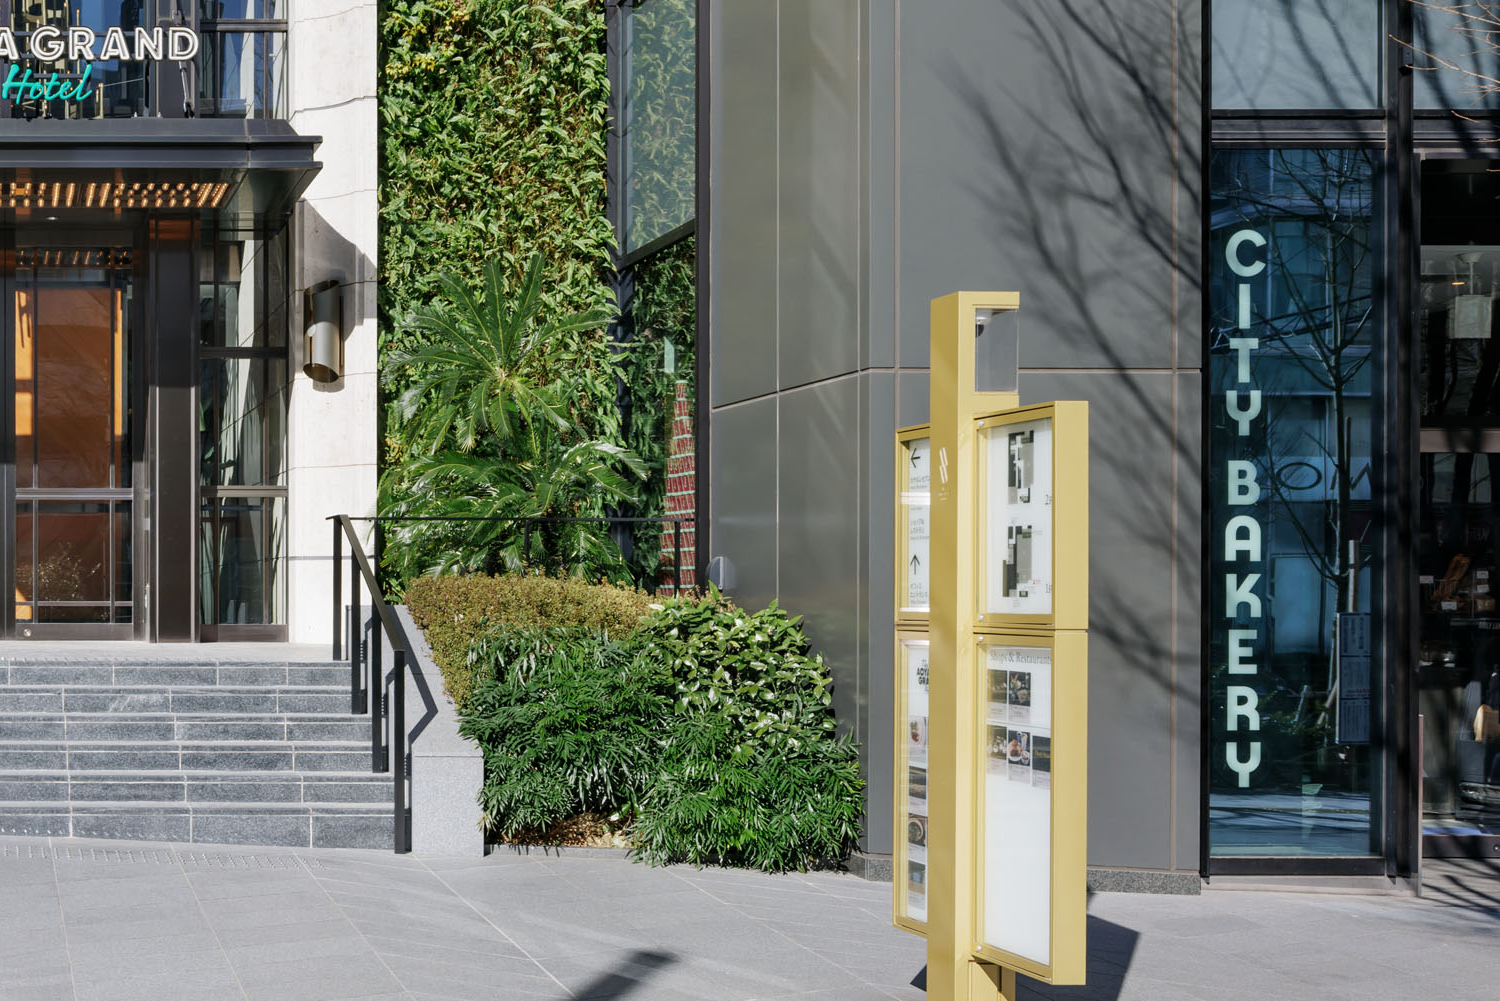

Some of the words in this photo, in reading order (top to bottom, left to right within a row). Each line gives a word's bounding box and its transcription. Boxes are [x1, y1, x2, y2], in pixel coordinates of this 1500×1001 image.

[2, 63, 93, 106] Hotel
[29, 25, 199, 62] GRAND
[1224, 228, 1267, 436] CITY
[1224, 460, 1262, 788] BAKERY
